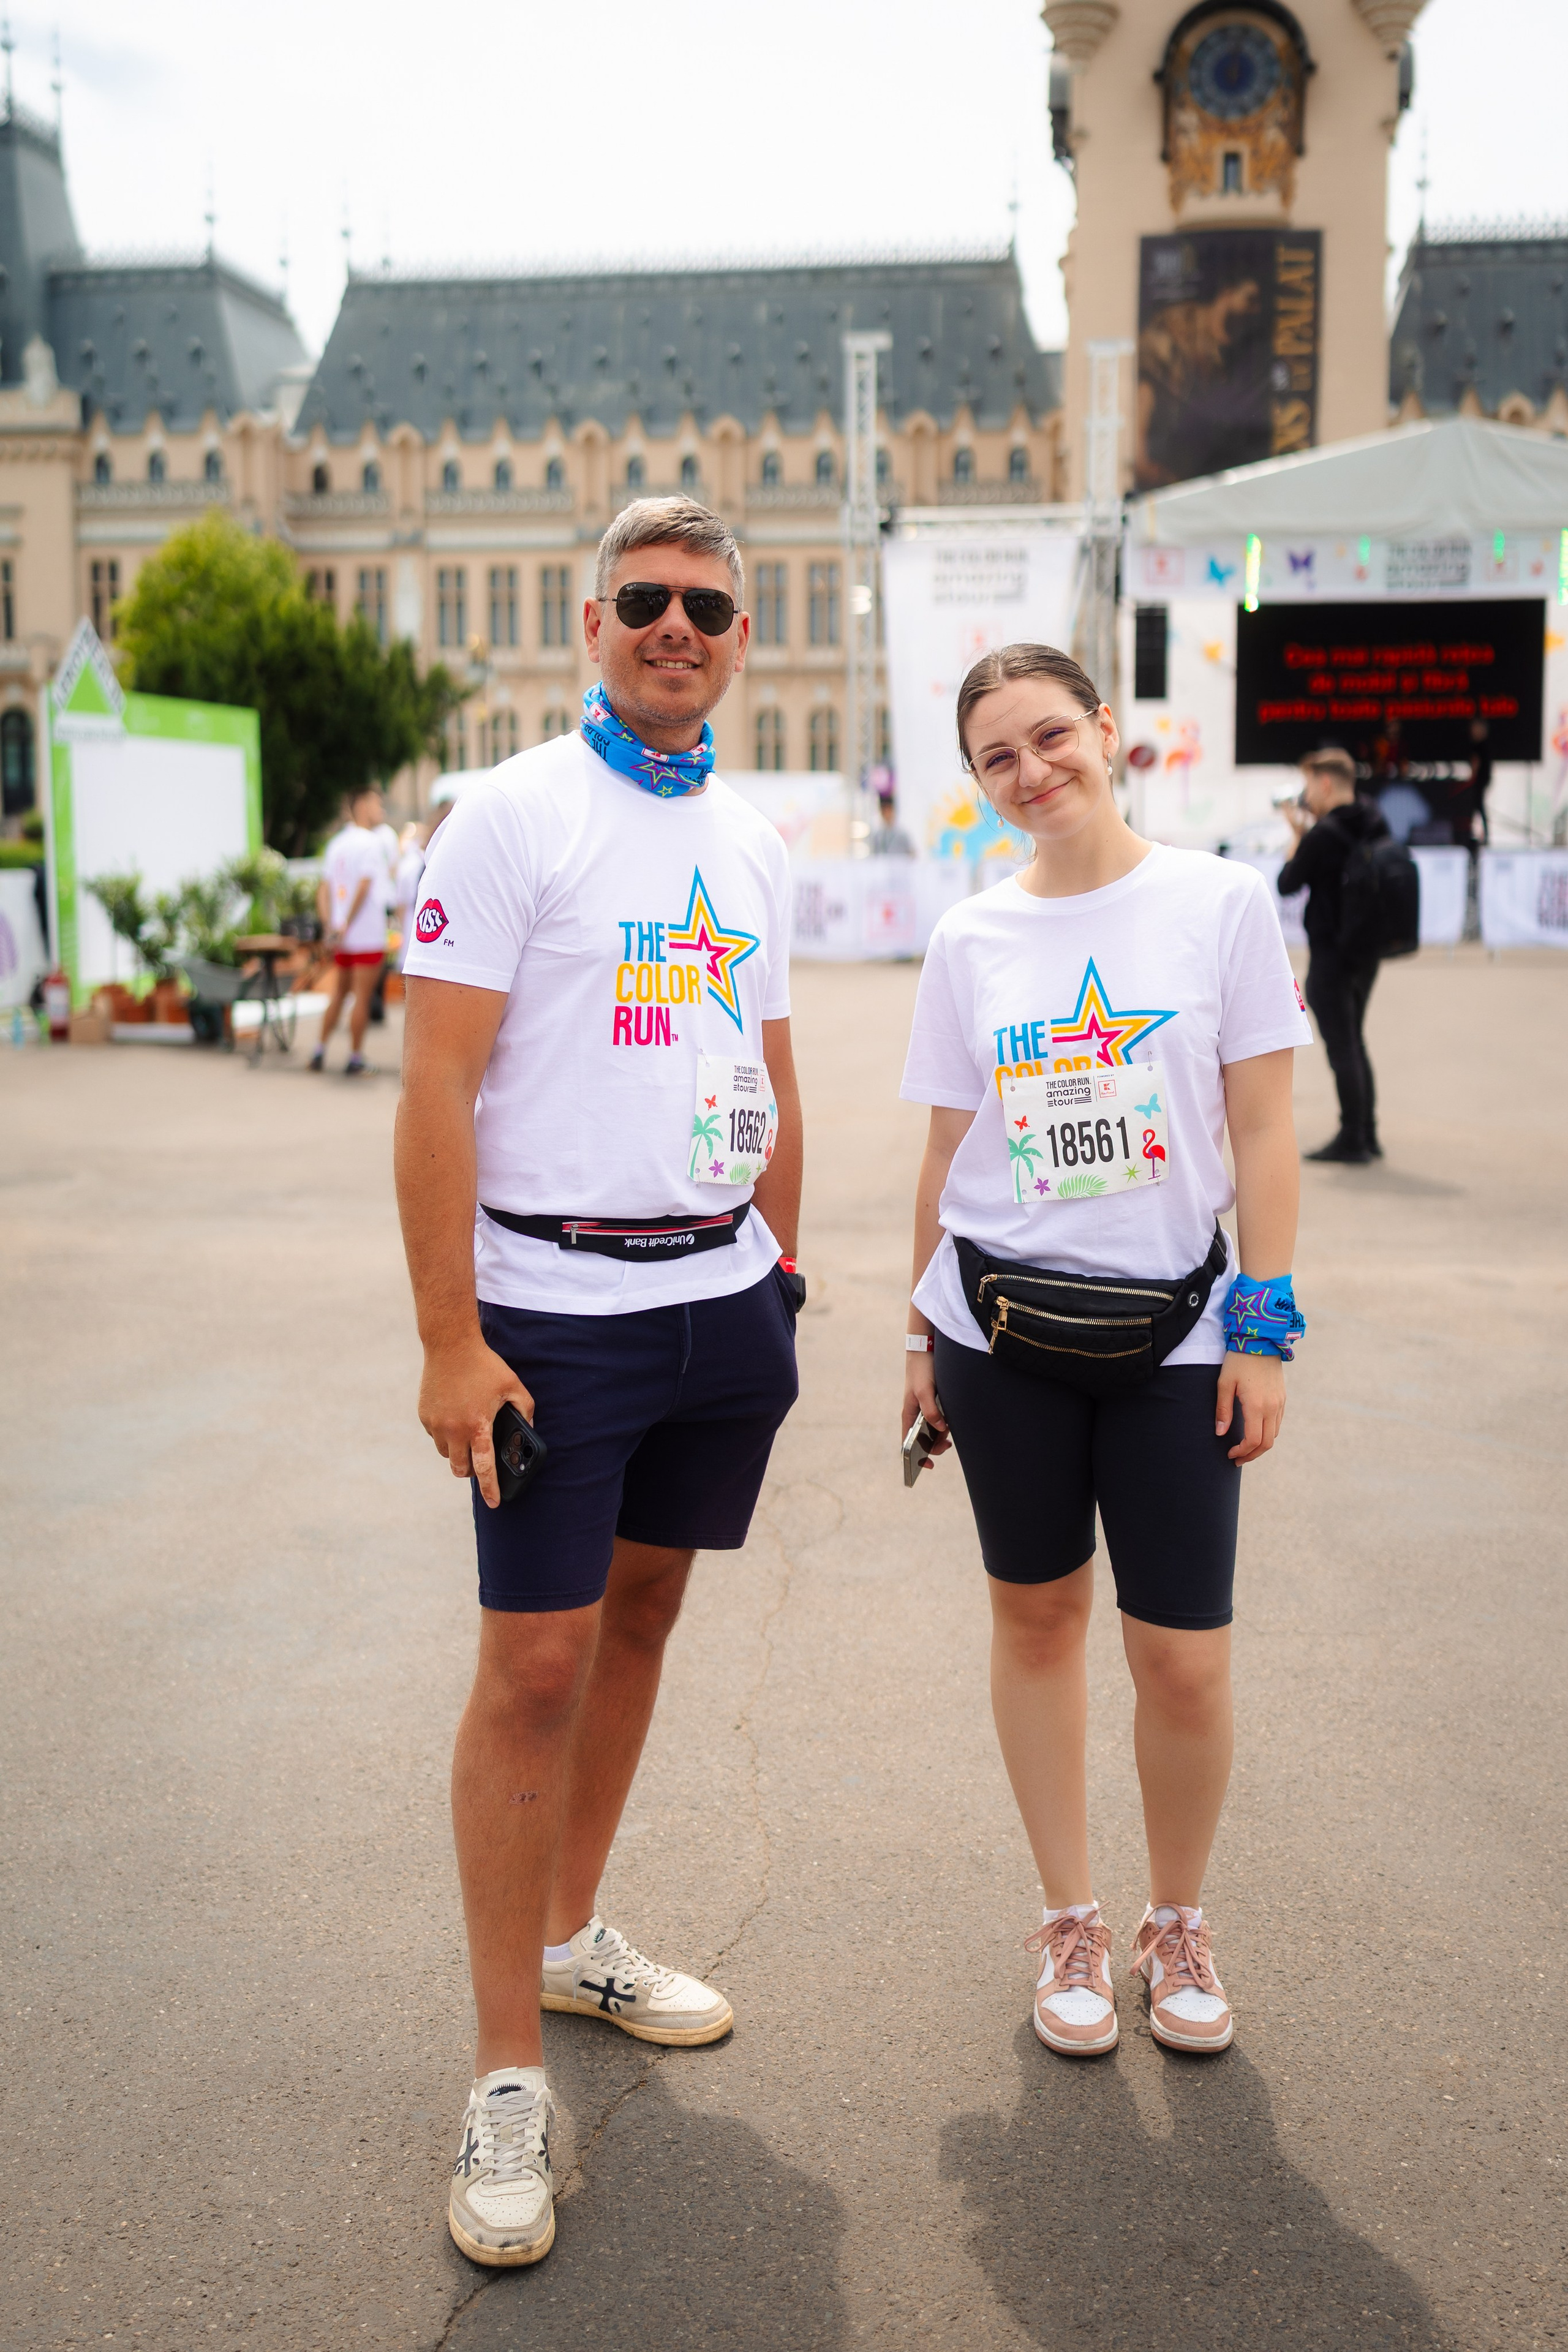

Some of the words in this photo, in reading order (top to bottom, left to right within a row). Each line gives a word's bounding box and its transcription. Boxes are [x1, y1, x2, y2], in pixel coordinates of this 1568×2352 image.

[619, 921, 666, 962] THE
[616, 963, 701, 1005] COLOR
[613, 1006, 671, 1046] RUN
[993, 1020, 1048, 1065] THE
[733, 1075, 758, 1087] amazing
[737, 1083, 748, 1092] tour
[1046, 1080, 1057, 1089] THE
[1058, 1079, 1077, 1088] COLOR
[1046, 1087, 1091, 1098] amazing
[729, 1108, 766, 1154] 18562
[1047, 1117, 1129, 1167] 18561
[624, 1238, 647, 1248] Bank
[649, 1235, 685, 1247] UniCredit
[1289, 1311, 1305, 1328] THE
